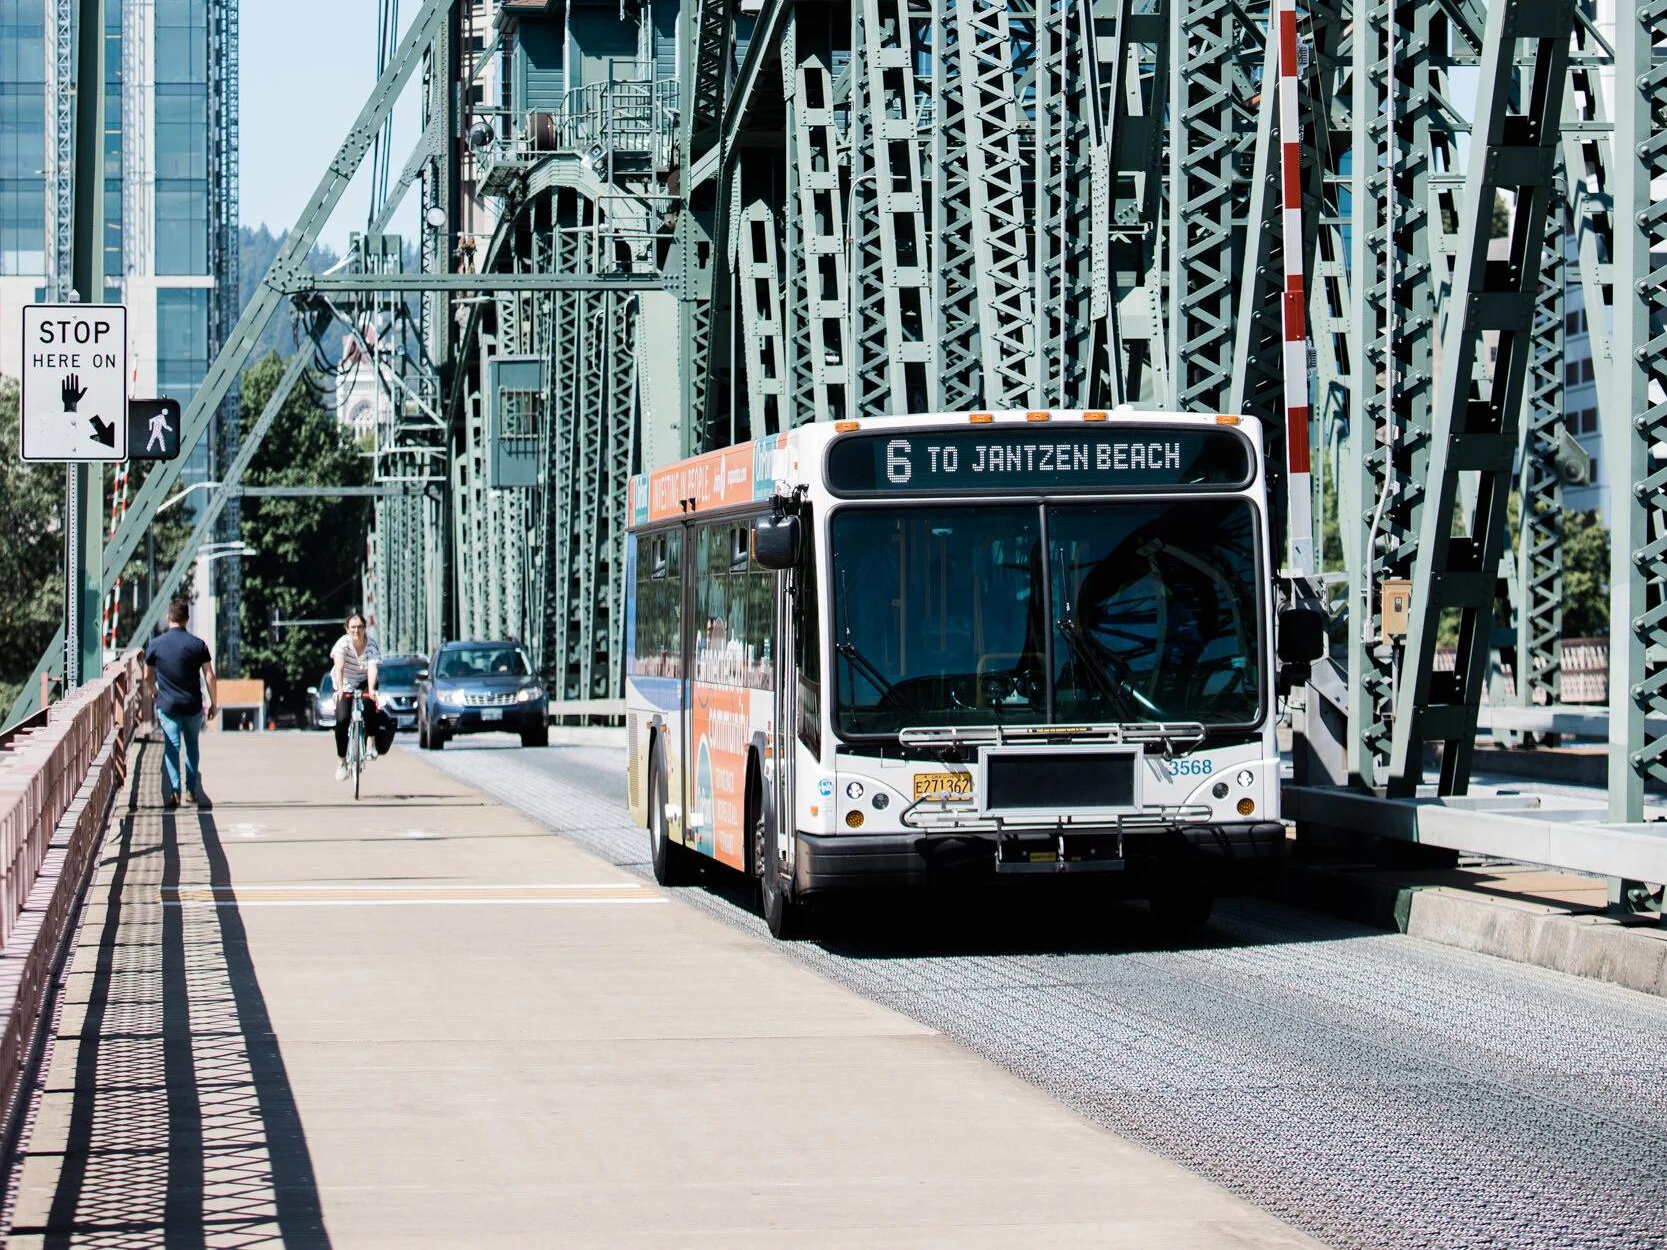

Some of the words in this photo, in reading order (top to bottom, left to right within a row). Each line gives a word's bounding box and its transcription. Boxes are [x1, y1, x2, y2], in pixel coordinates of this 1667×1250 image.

[39, 320, 111, 344] STOP
[33, 353, 81, 368] HERE
[92, 353, 116, 368] ON
[886, 439, 912, 483] 6
[927, 446, 958, 473] TO
[972, 444, 1089, 472] JANTZEN
[1096, 442, 1180, 470] BEACH
[1168, 759, 1213, 777] 3568
[915, 778, 969, 793] E271362
